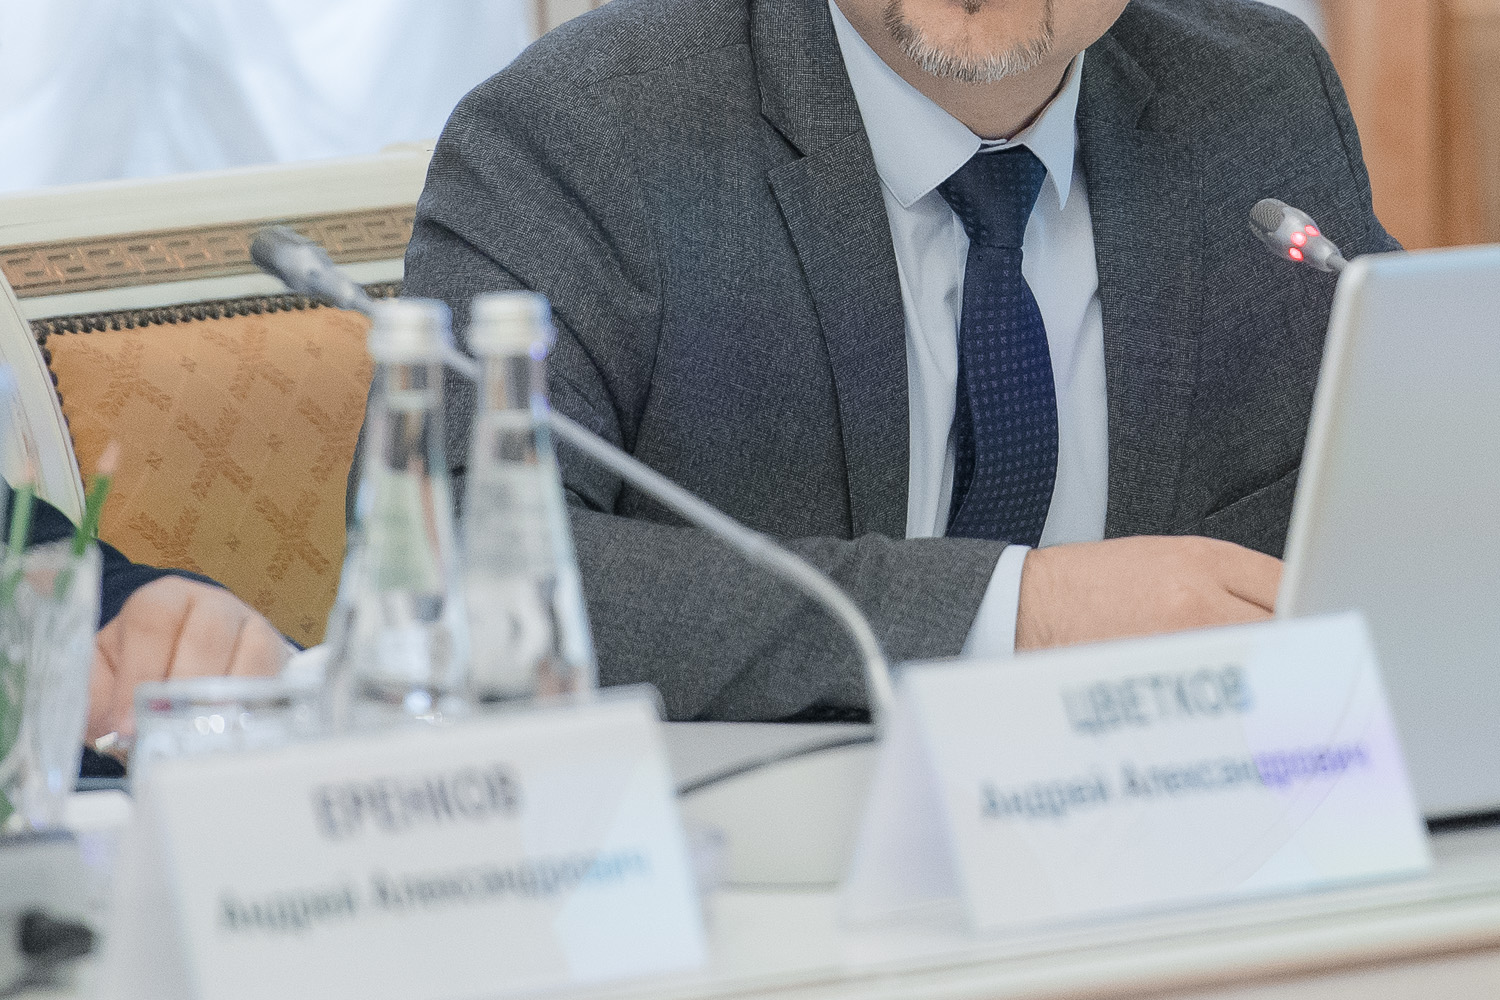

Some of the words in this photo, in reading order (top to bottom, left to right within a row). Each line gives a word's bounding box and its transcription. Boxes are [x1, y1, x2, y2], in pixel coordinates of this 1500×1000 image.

[1062, 666, 1255, 734] ЦВЕТКОВ
[980, 768, 1110, 821] Андрей
[1122, 741, 1371, 795] Александрович
